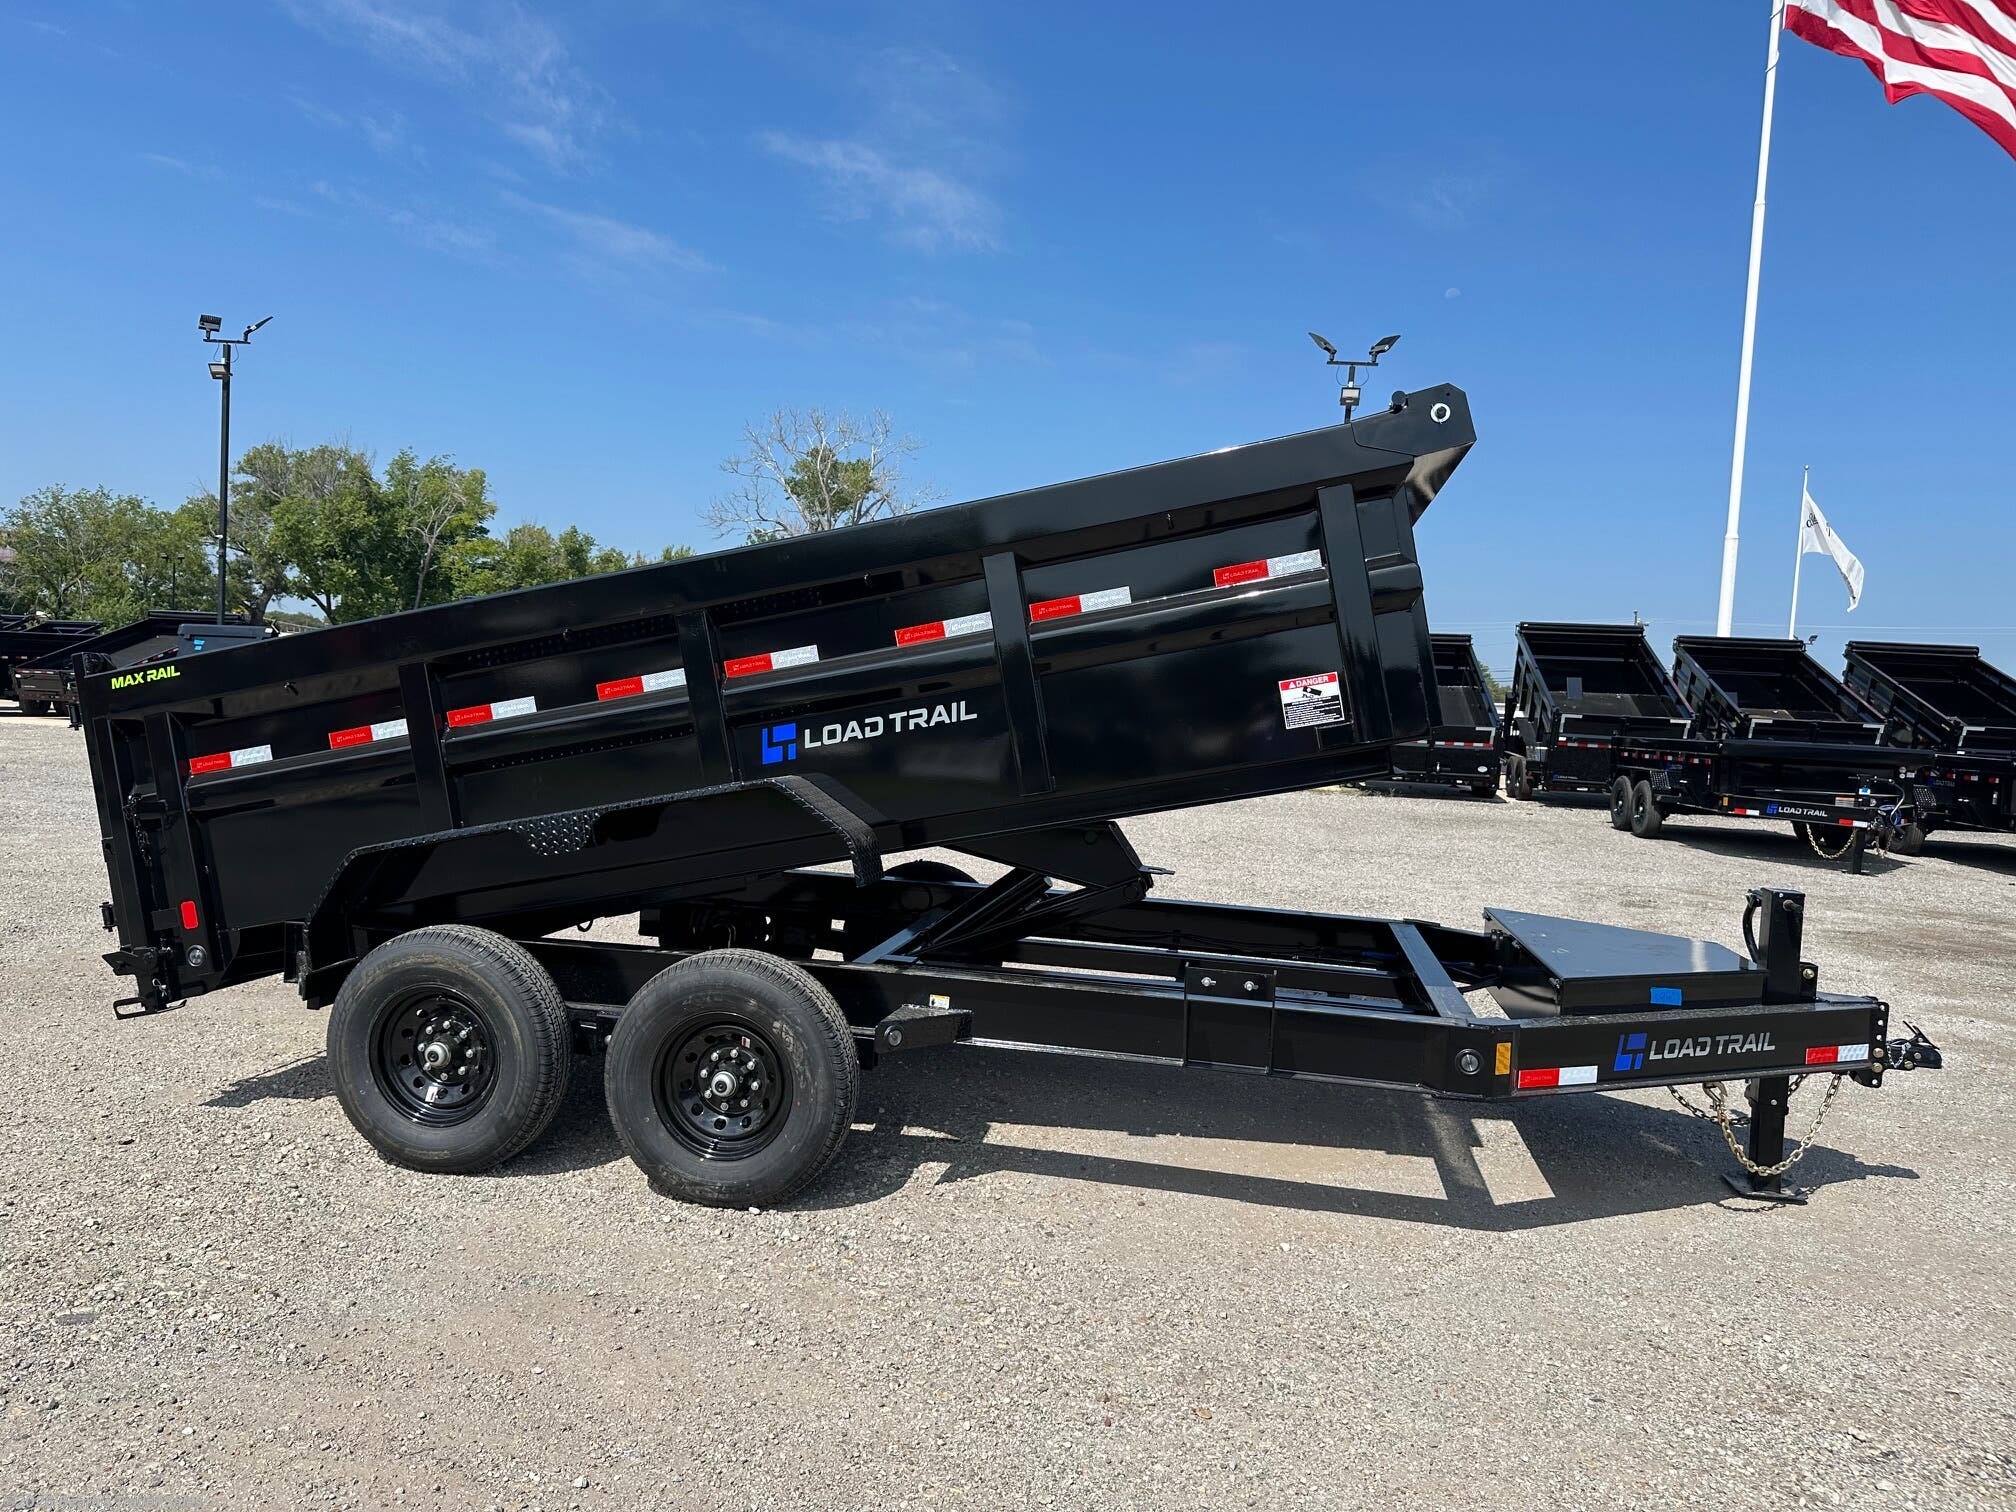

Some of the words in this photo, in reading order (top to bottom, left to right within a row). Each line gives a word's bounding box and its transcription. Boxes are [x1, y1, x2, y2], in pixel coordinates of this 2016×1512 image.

[111, 672, 144, 690] MAX
[147, 665, 181, 683] RAIL
[1296, 676, 1329, 688] DANGER
[804, 716, 884, 749] LOAD
[889, 700, 978, 732] TRAIL
[1778, 806, 1801, 815] LOAD
[1801, 808, 1828, 818] TRAIL
[1649, 1036, 1712, 1060] LOAD
[1715, 1032, 1776, 1055] TRAIL
